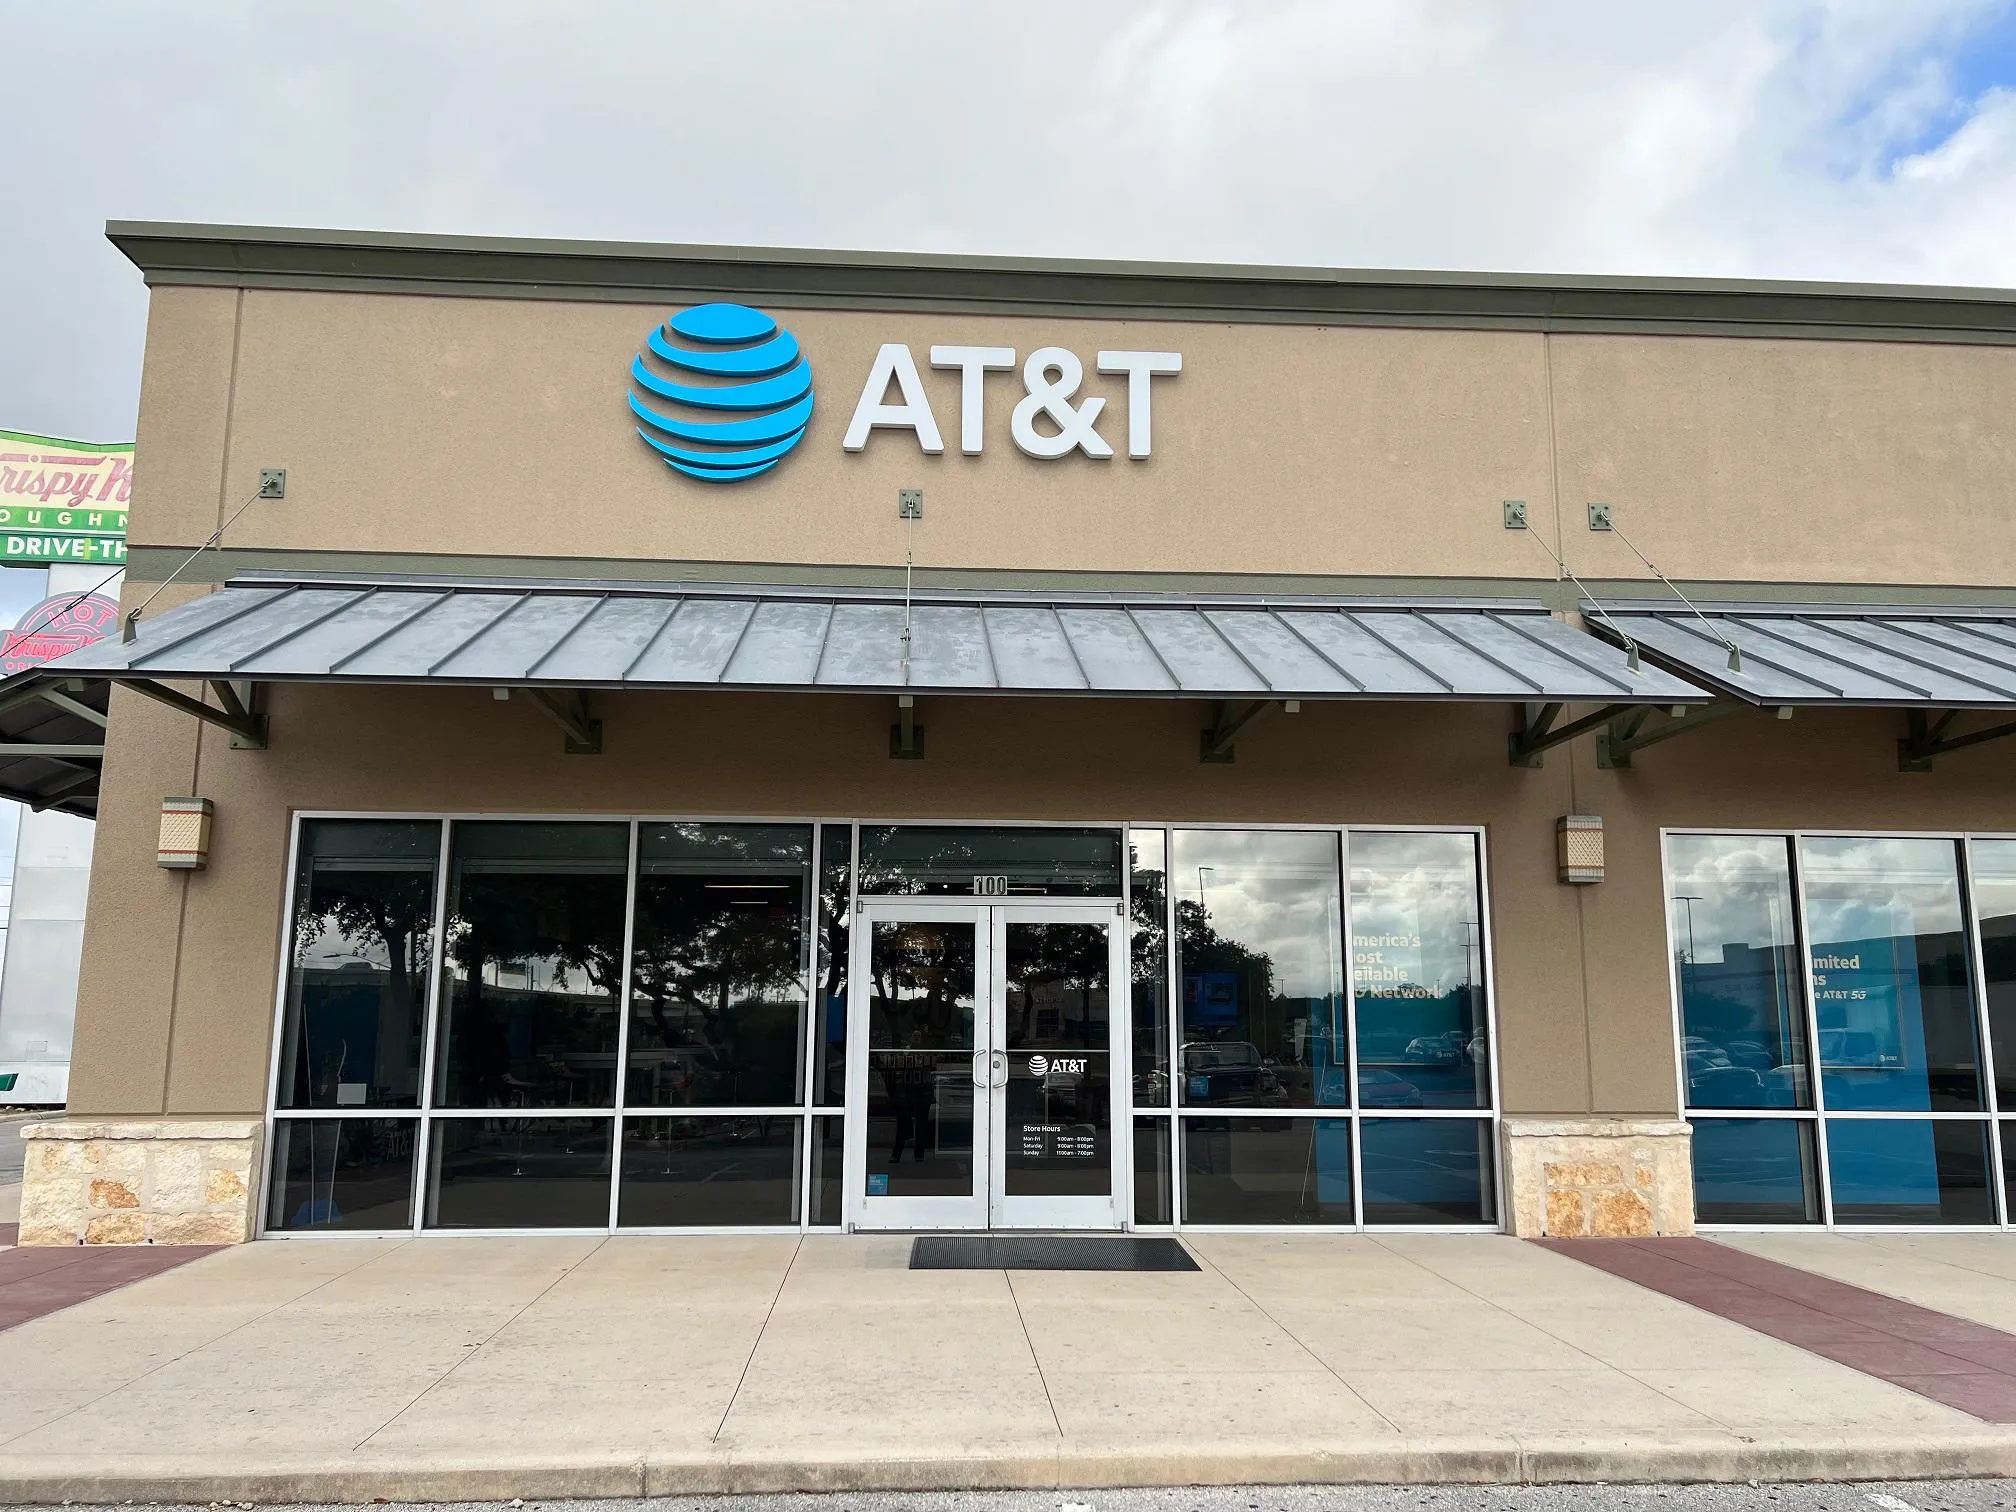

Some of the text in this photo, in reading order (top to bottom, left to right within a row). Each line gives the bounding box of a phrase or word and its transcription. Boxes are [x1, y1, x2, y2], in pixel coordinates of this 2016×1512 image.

[842, 343, 1182, 460] AT&T
[0, 455, 99, 507] rispy
[48, 603, 113, 628] HOT
[976, 876, 1006, 894] 100
[1353, 932, 1421, 947] merica's
[1355, 951, 1384, 964] ost
[1354, 966, 1409, 981] eliable
[1371, 984, 1442, 999] Network
[1823, 990, 1848, 999] AT&T
[1850, 990, 1867, 1000] 5G
[1050, 1059, 1088, 1073] AT&T
